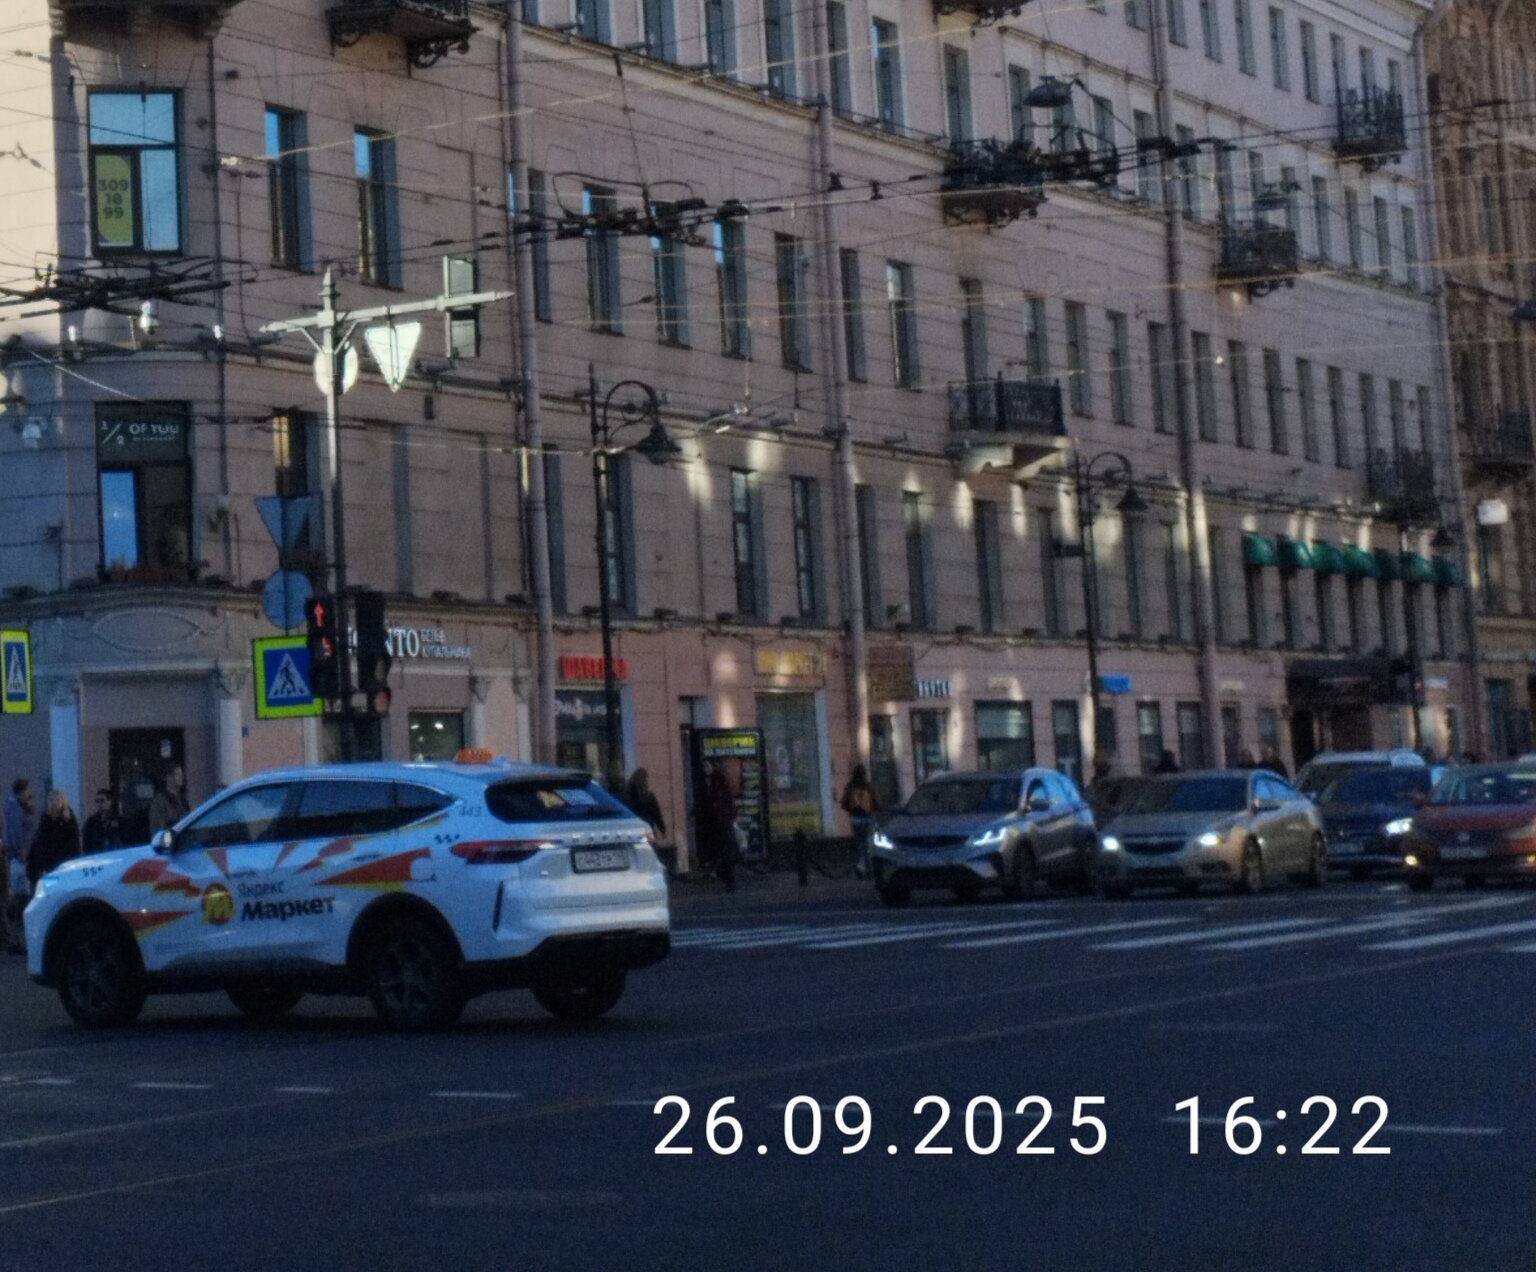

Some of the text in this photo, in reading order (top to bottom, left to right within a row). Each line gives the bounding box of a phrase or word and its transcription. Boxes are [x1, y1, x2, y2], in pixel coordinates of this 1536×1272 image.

[97, 178, 130, 192] 309
[105, 192, 123, 205] 18
[103, 206, 124, 219] 99
[237, 880, 284, 898] Яндекс
[241, 896, 336, 922] Маркет
